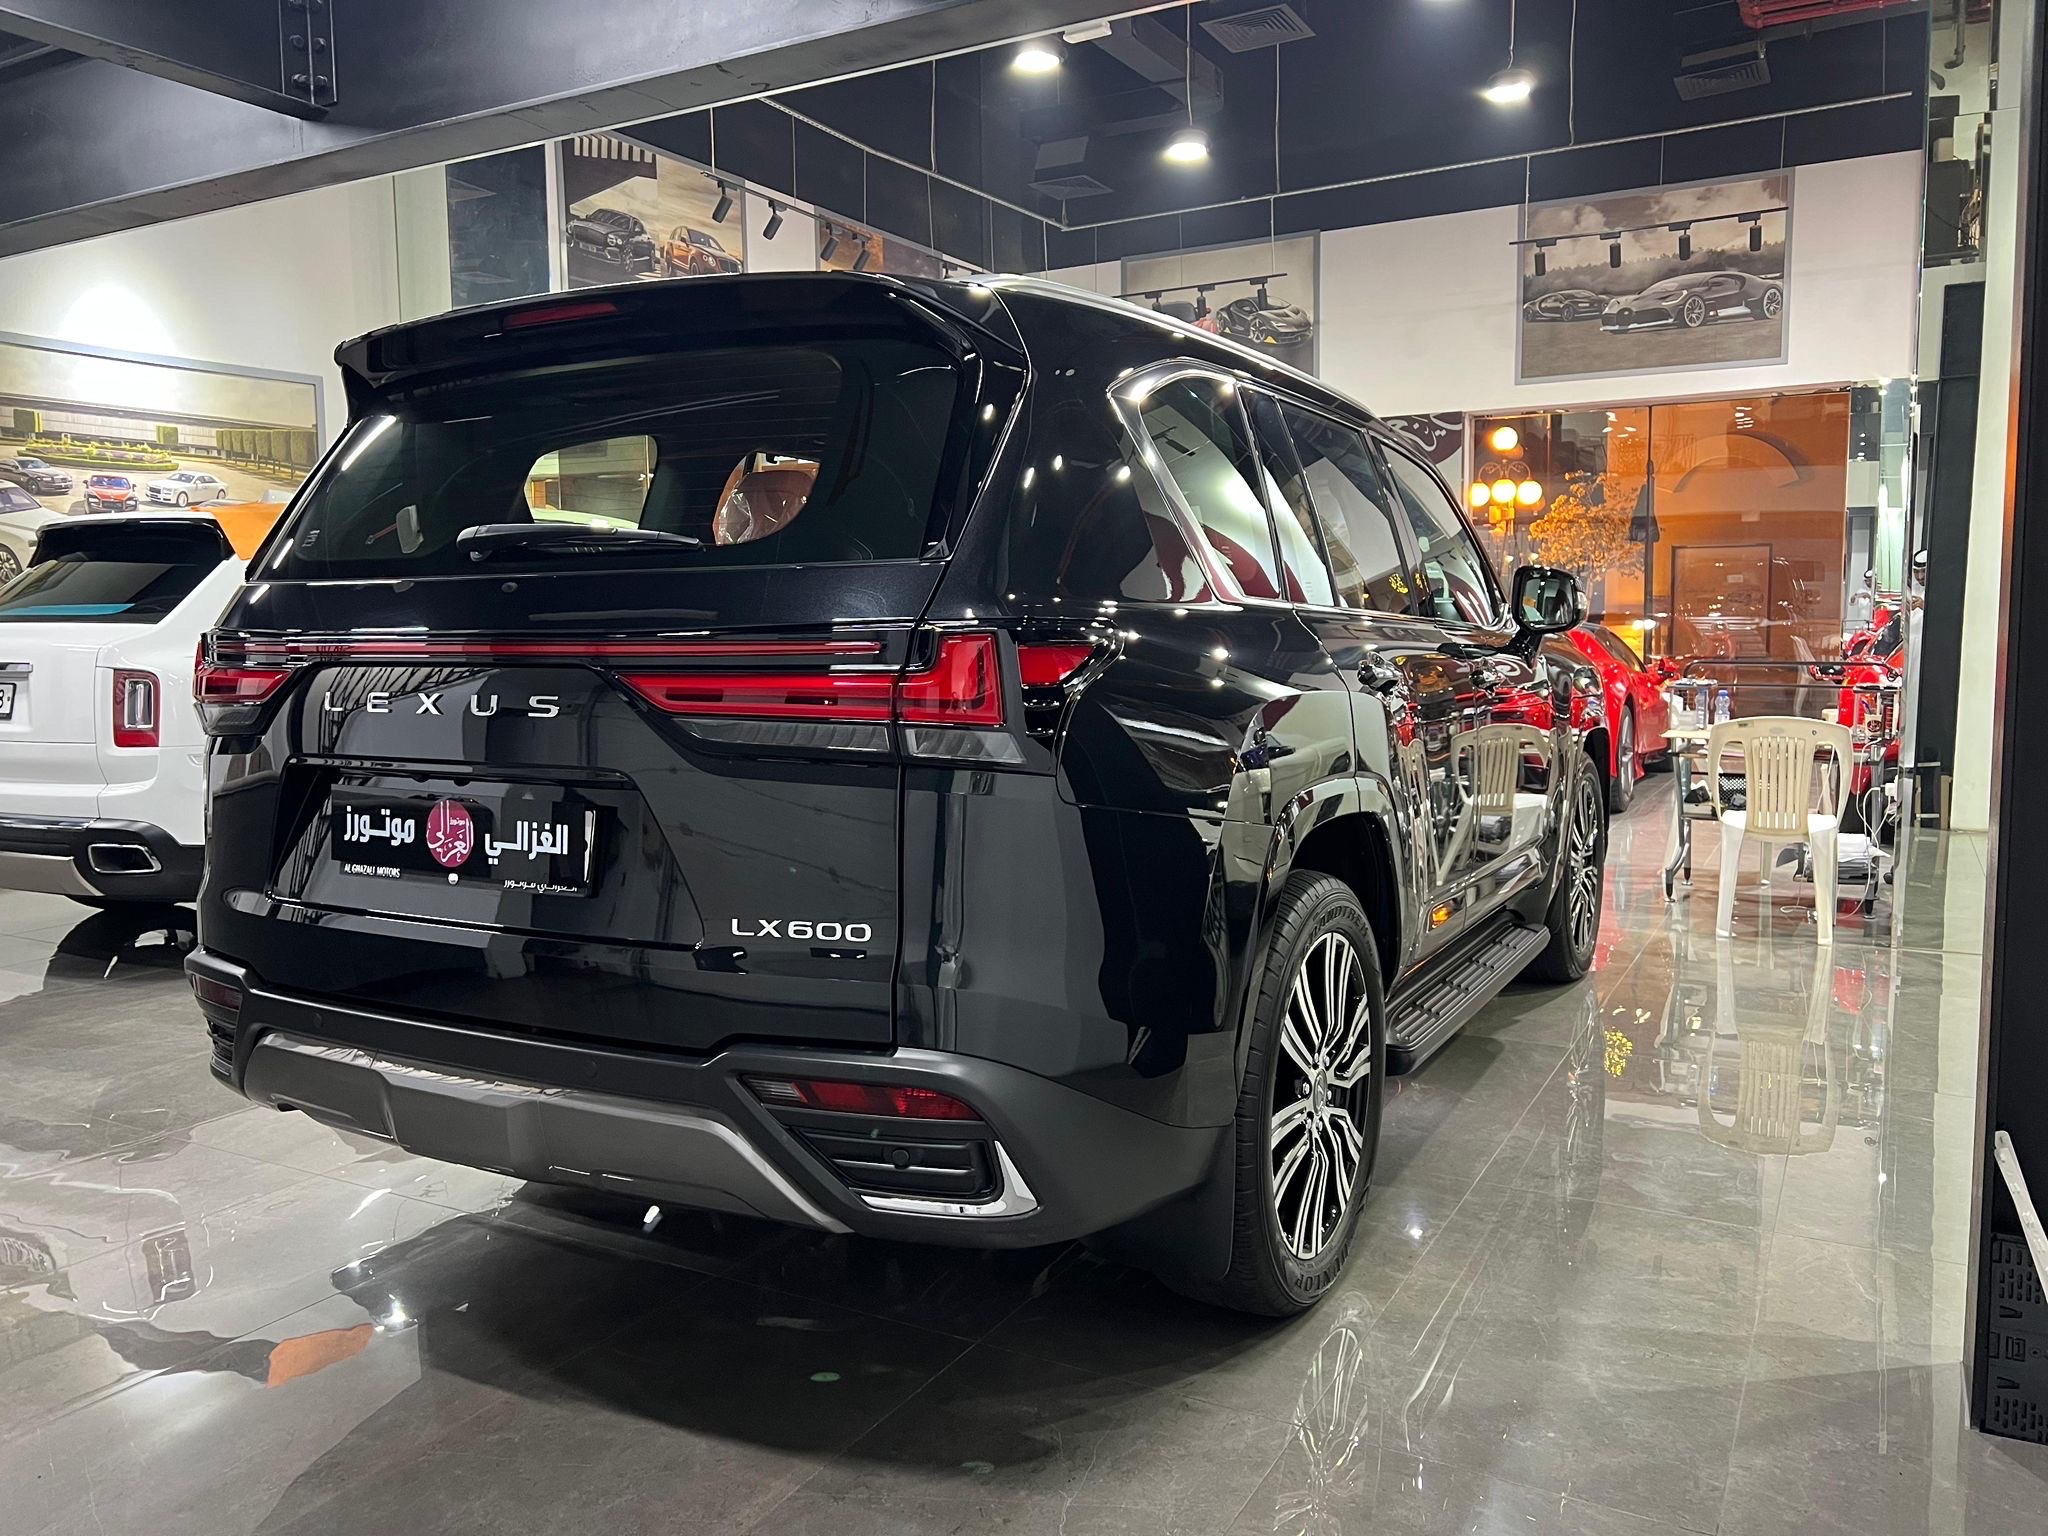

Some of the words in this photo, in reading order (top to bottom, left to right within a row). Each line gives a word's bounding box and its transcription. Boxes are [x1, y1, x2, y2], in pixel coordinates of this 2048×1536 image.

[323, 691, 561, 718] LEXUS
[343, 805, 416, 847] موتورز
[484, 820, 569, 865] الغزالي
[376, 865, 401, 878] MOTORS
